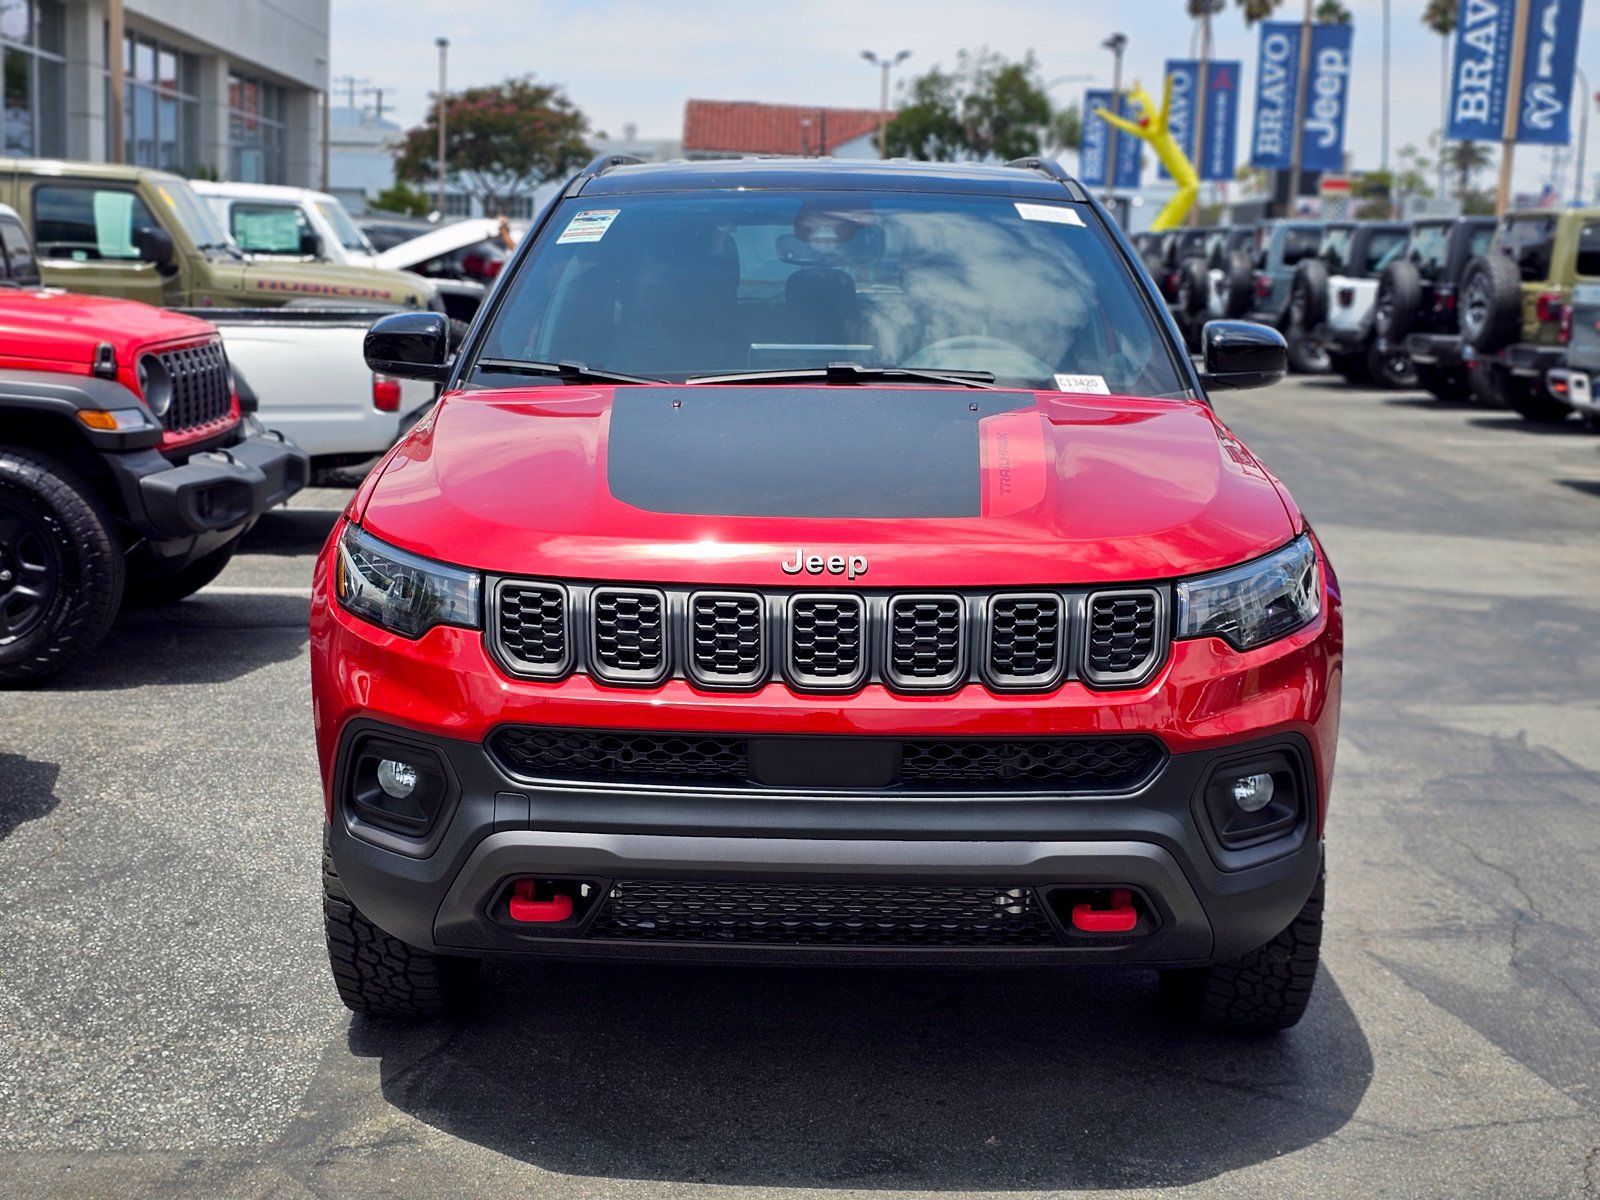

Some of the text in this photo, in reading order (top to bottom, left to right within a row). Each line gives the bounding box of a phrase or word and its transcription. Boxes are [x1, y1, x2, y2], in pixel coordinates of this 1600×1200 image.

[1256, 33, 1290, 155] BRAVO
[1305, 47, 1347, 148] Jeep
[256, 279, 392, 299] RUBICON
[996, 431, 1013, 497] TRAILHAWK
[780, 548, 869, 581] Jeep
